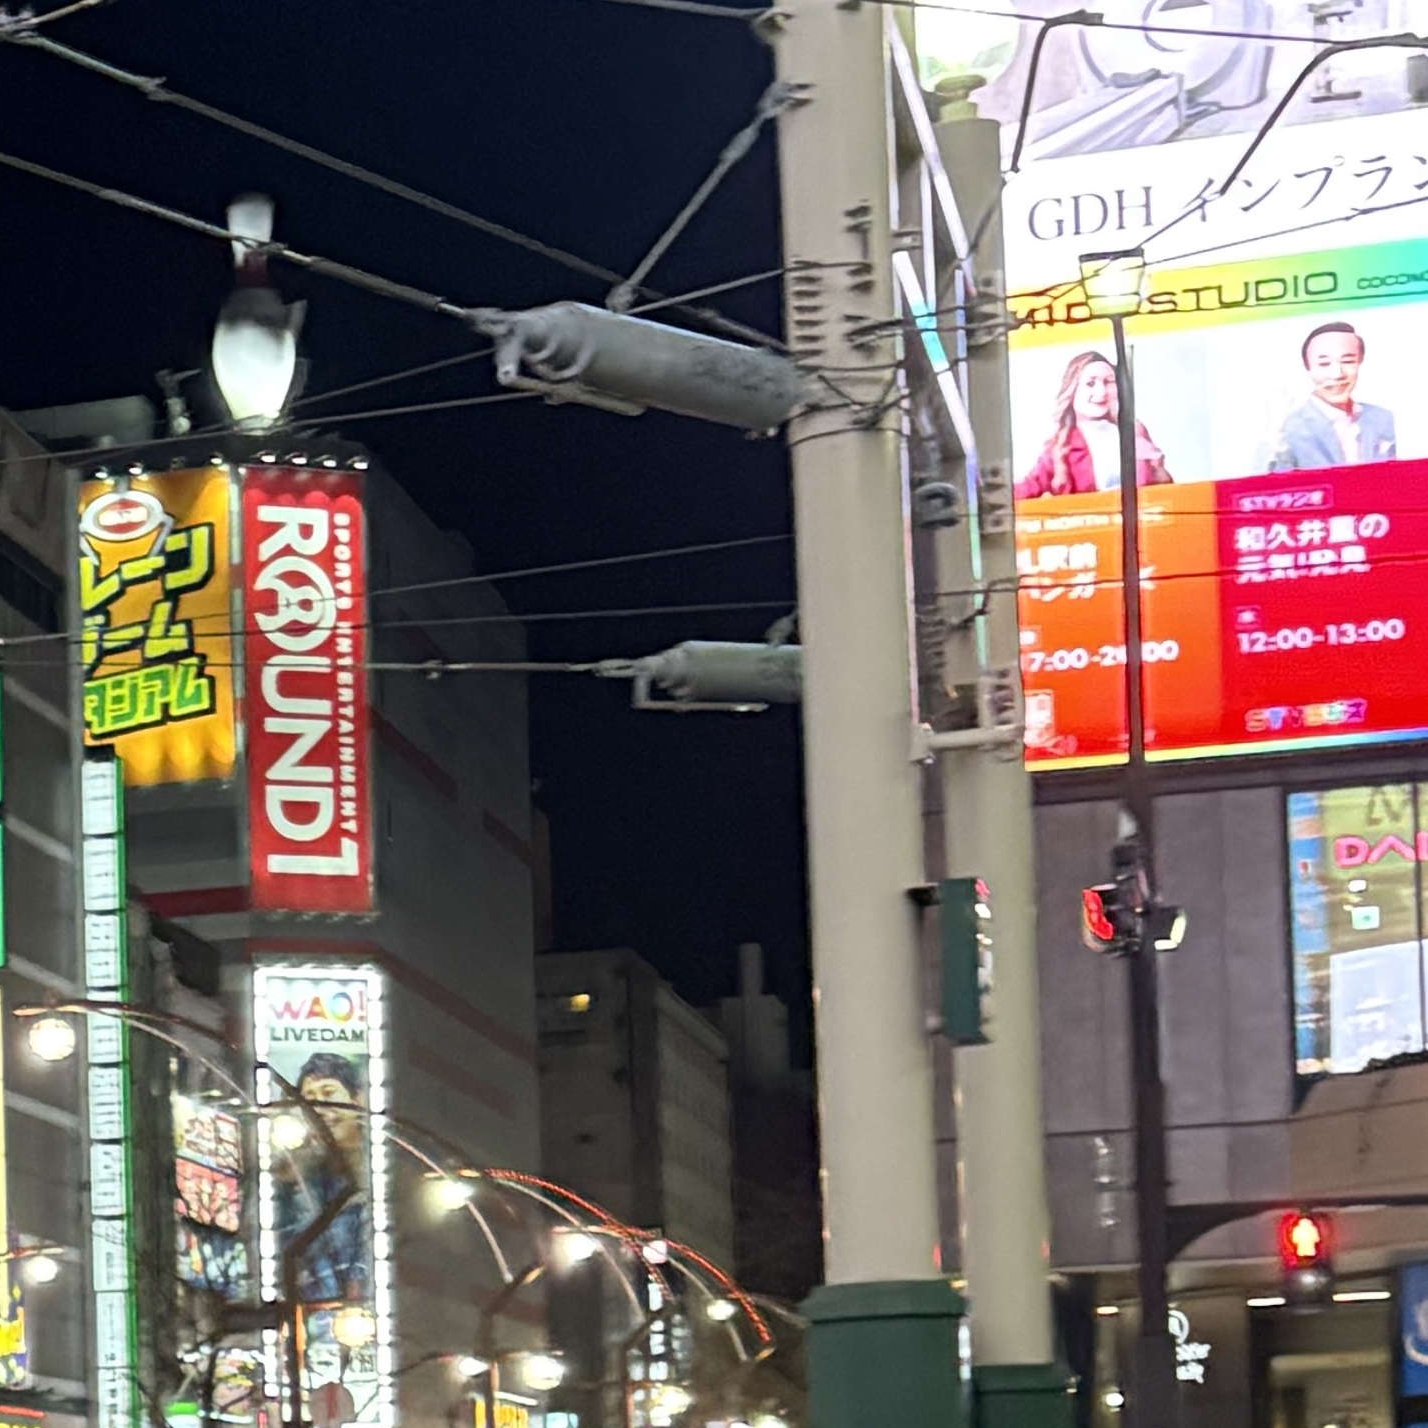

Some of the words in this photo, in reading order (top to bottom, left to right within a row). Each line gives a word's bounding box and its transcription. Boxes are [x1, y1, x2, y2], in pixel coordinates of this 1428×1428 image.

[1028, 186, 1153, 240] GDH
[1147, 272, 1338, 314] STUDIO
[333, 513, 353, 609] SPORTS
[1237, 618, 1405, 654] 12:00-13:00
[254, 505, 359, 876] ROUND1
[270, 989, 365, 1021] WAO!
[270, 1027, 365, 1043] LIVEDAM
